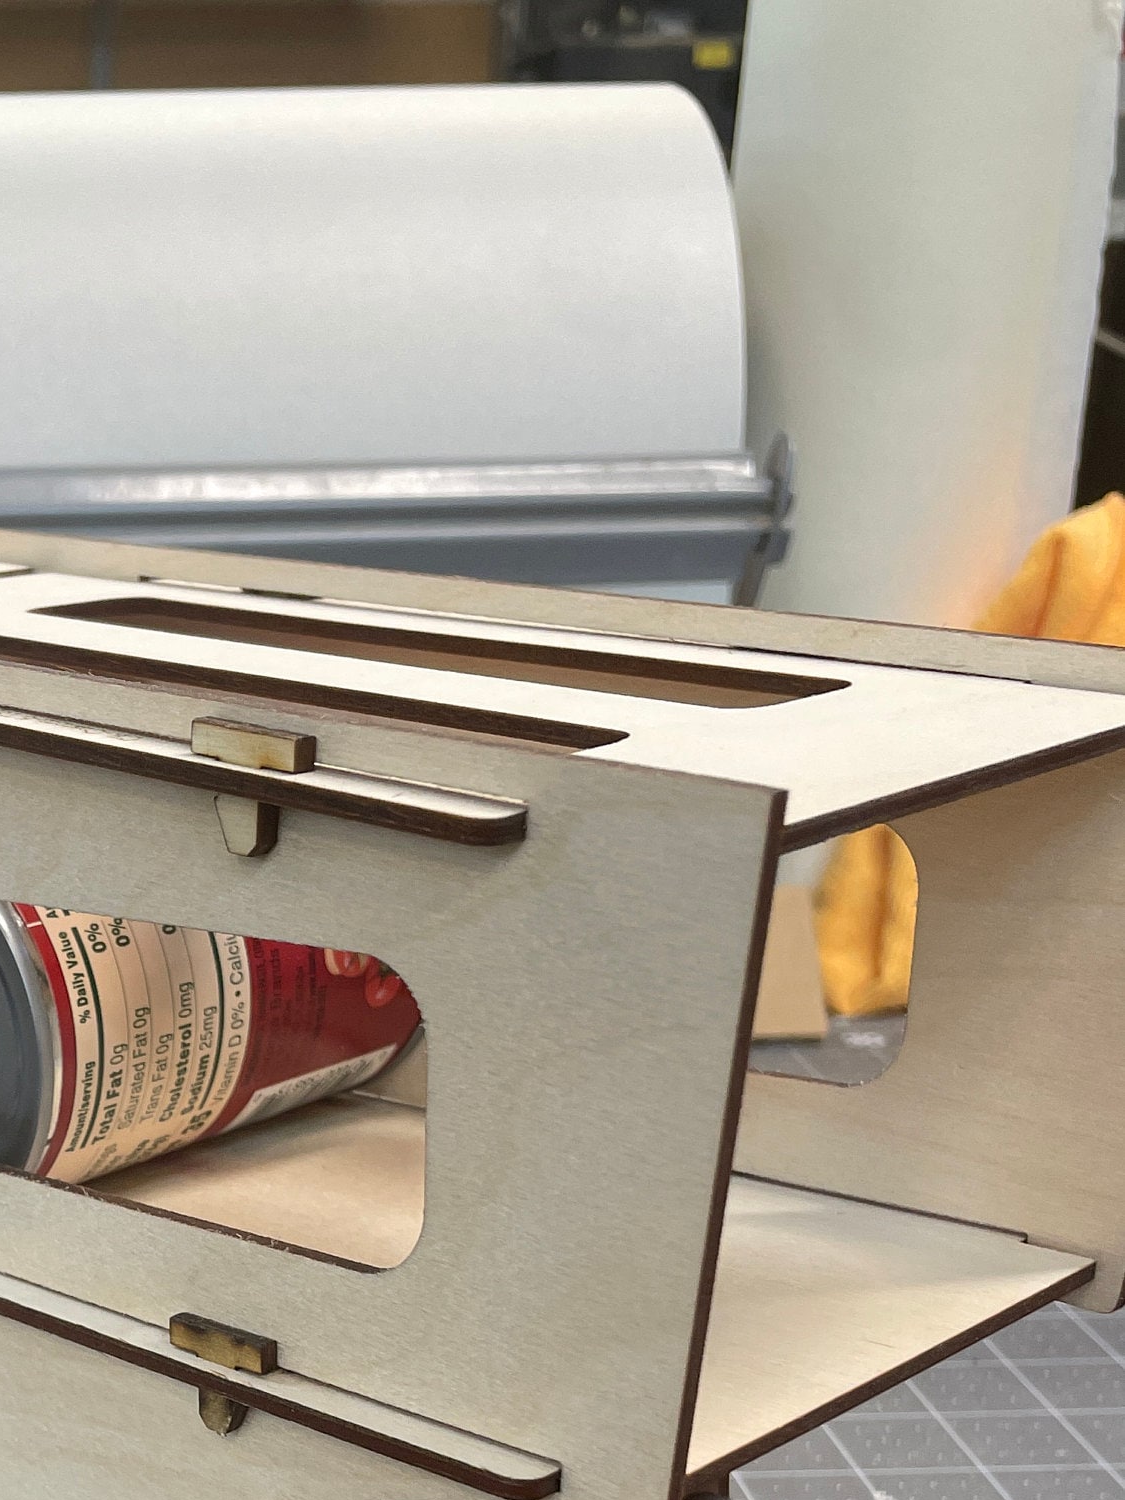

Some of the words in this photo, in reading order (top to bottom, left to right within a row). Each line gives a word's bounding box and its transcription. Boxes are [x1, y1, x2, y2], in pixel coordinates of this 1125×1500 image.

[58, 931, 77, 969] Value
[84, 923, 107, 953] 0%
[72, 972, 90, 1007] Daily
[133, 1007, 151, 1029] 0g
[231, 1002, 245, 1030] 0%
[110, 1043, 129, 1066] 0g
[133, 1033, 148, 1059] Fat
[156, 1033, 174, 1054] 0g
[159, 1023, 192, 1122] Cholesterol
[178, 981, 195, 1018] 0mg
[228, 1034, 241, 1048] D
[152, 1058, 168, 1082] Fat
[180, 1054, 210, 1115] Sodium
[199, 1006, 217, 1051] 25mg
[106, 1069, 124, 1100] Fat
[213, 1051, 240, 1104] Vitamin
[118, 1061, 146, 1130] Saturated
[139, 1084, 163, 1123] Trans
[91, 1103, 117, 1145] Total
